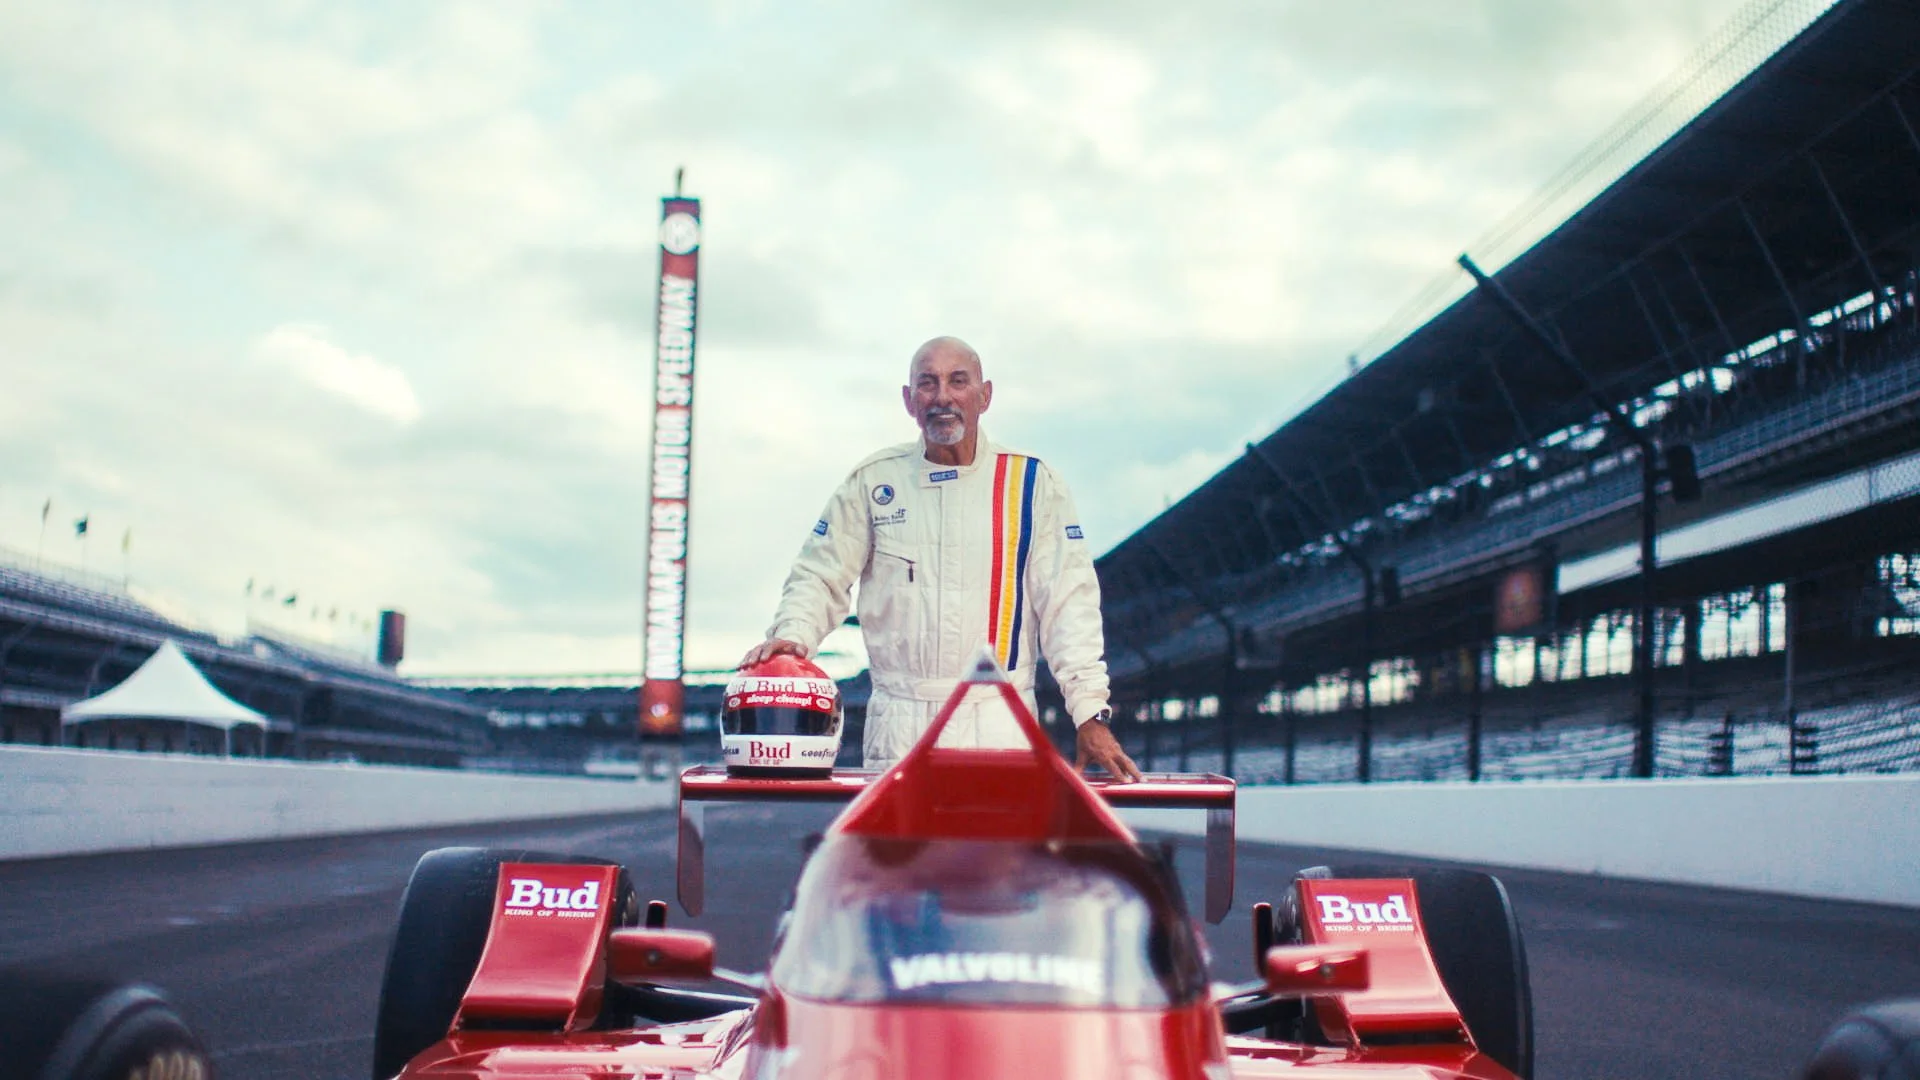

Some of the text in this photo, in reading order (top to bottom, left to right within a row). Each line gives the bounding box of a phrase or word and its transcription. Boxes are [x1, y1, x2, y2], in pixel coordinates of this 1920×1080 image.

[645, 273, 695, 680] INDIANAPOLIS MOTOR SPEEDWAY
[757, 680, 795, 693] Bud
[749, 741, 791, 759] Bud
[505, 879, 600, 910] Bud
[1316, 895, 1412, 923] Bud
